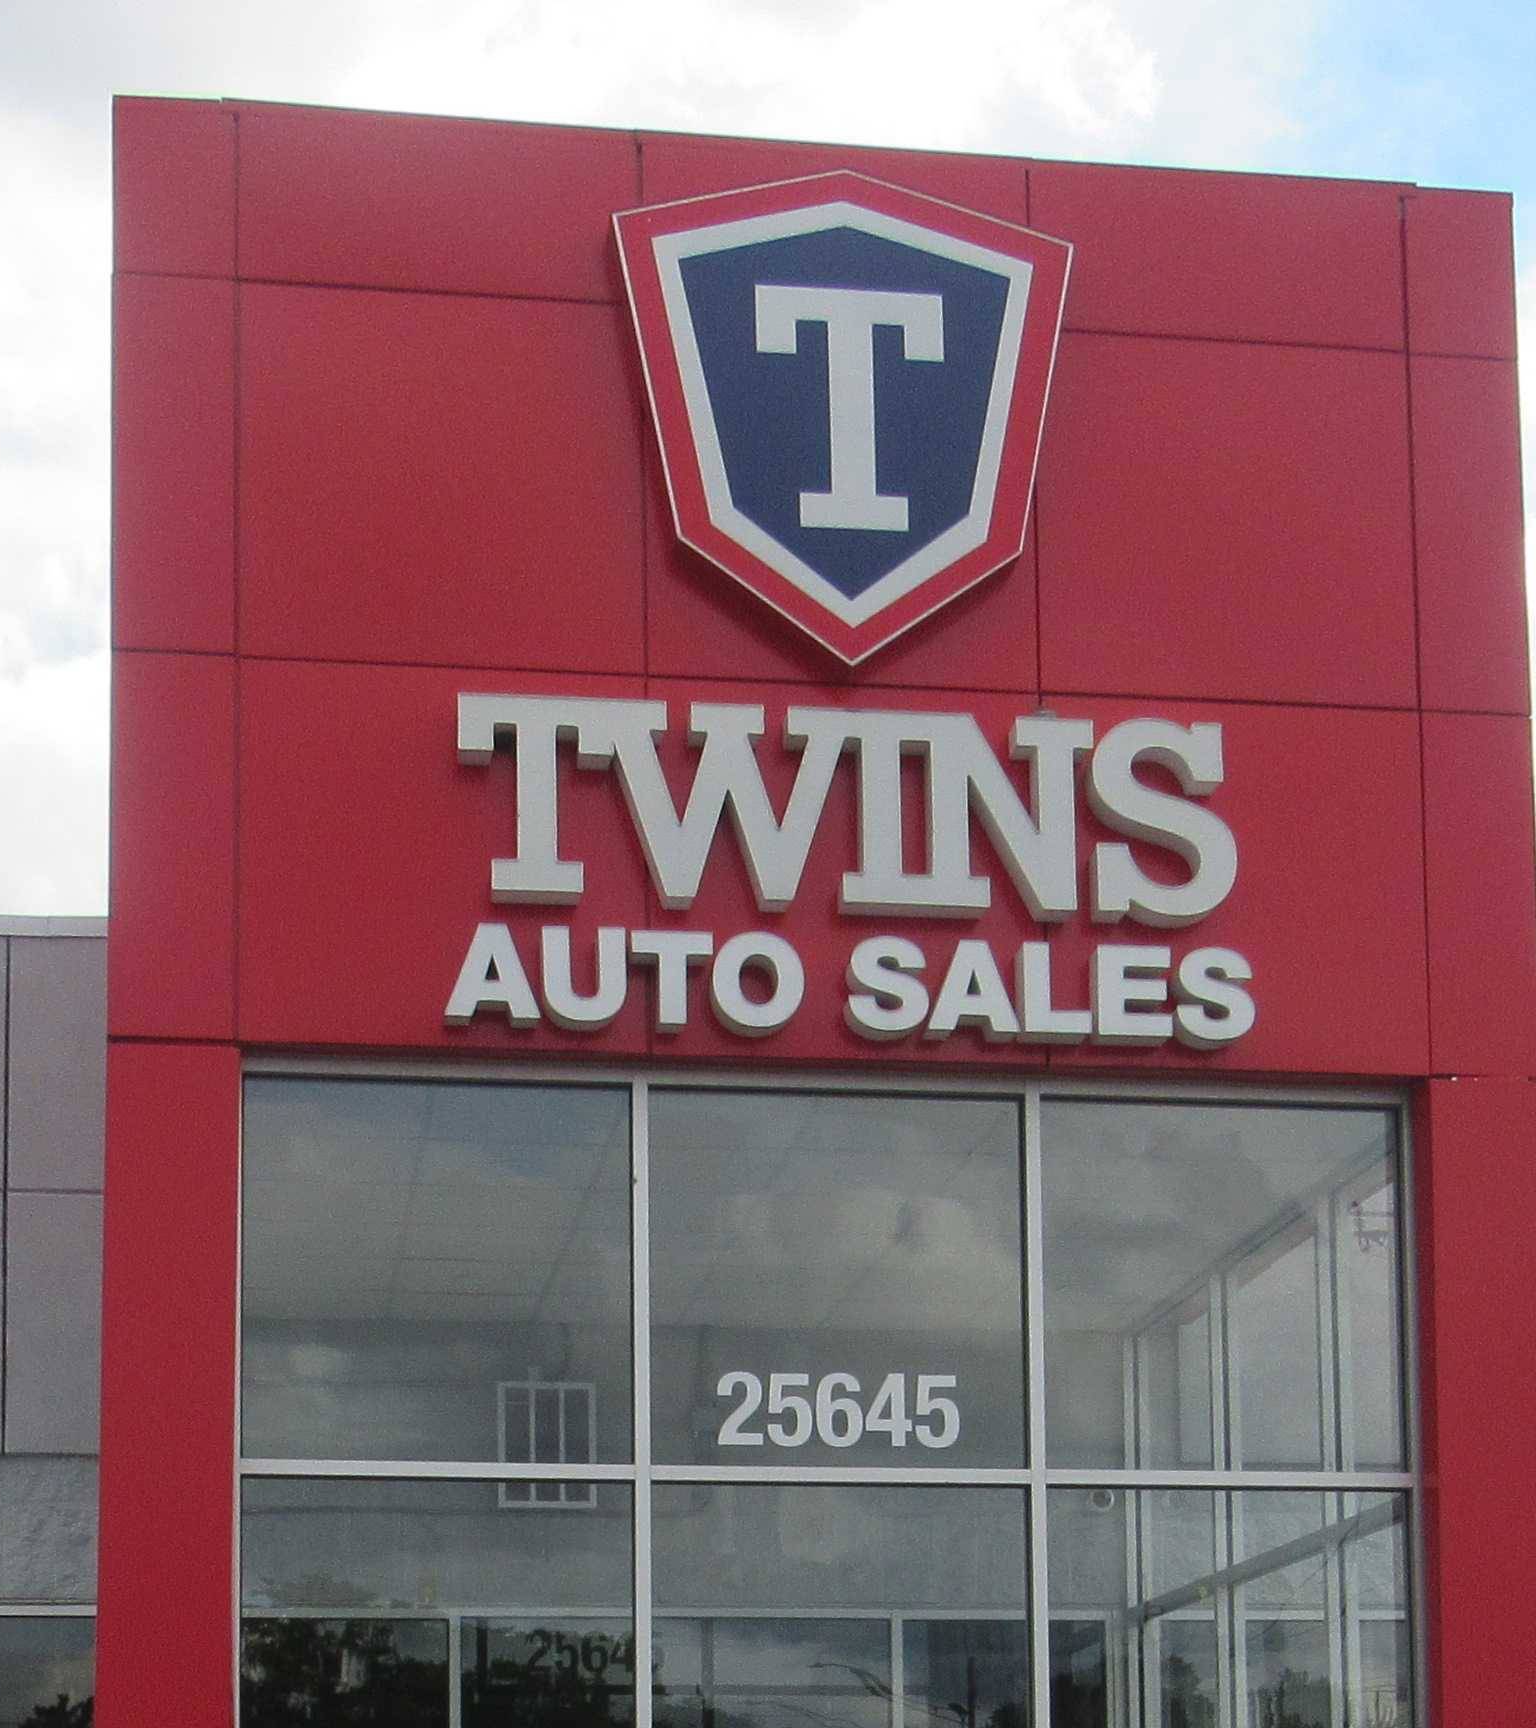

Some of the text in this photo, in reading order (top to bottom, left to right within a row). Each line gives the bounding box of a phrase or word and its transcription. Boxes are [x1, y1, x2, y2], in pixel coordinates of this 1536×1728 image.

[754, 284, 944, 532] T
[457, 692, 1238, 927] TWINS
[444, 923, 1255, 1050] AUTO SALES
[716, 1371, 961, 1449] 25645
[525, 1629, 664, 1674] 2564
